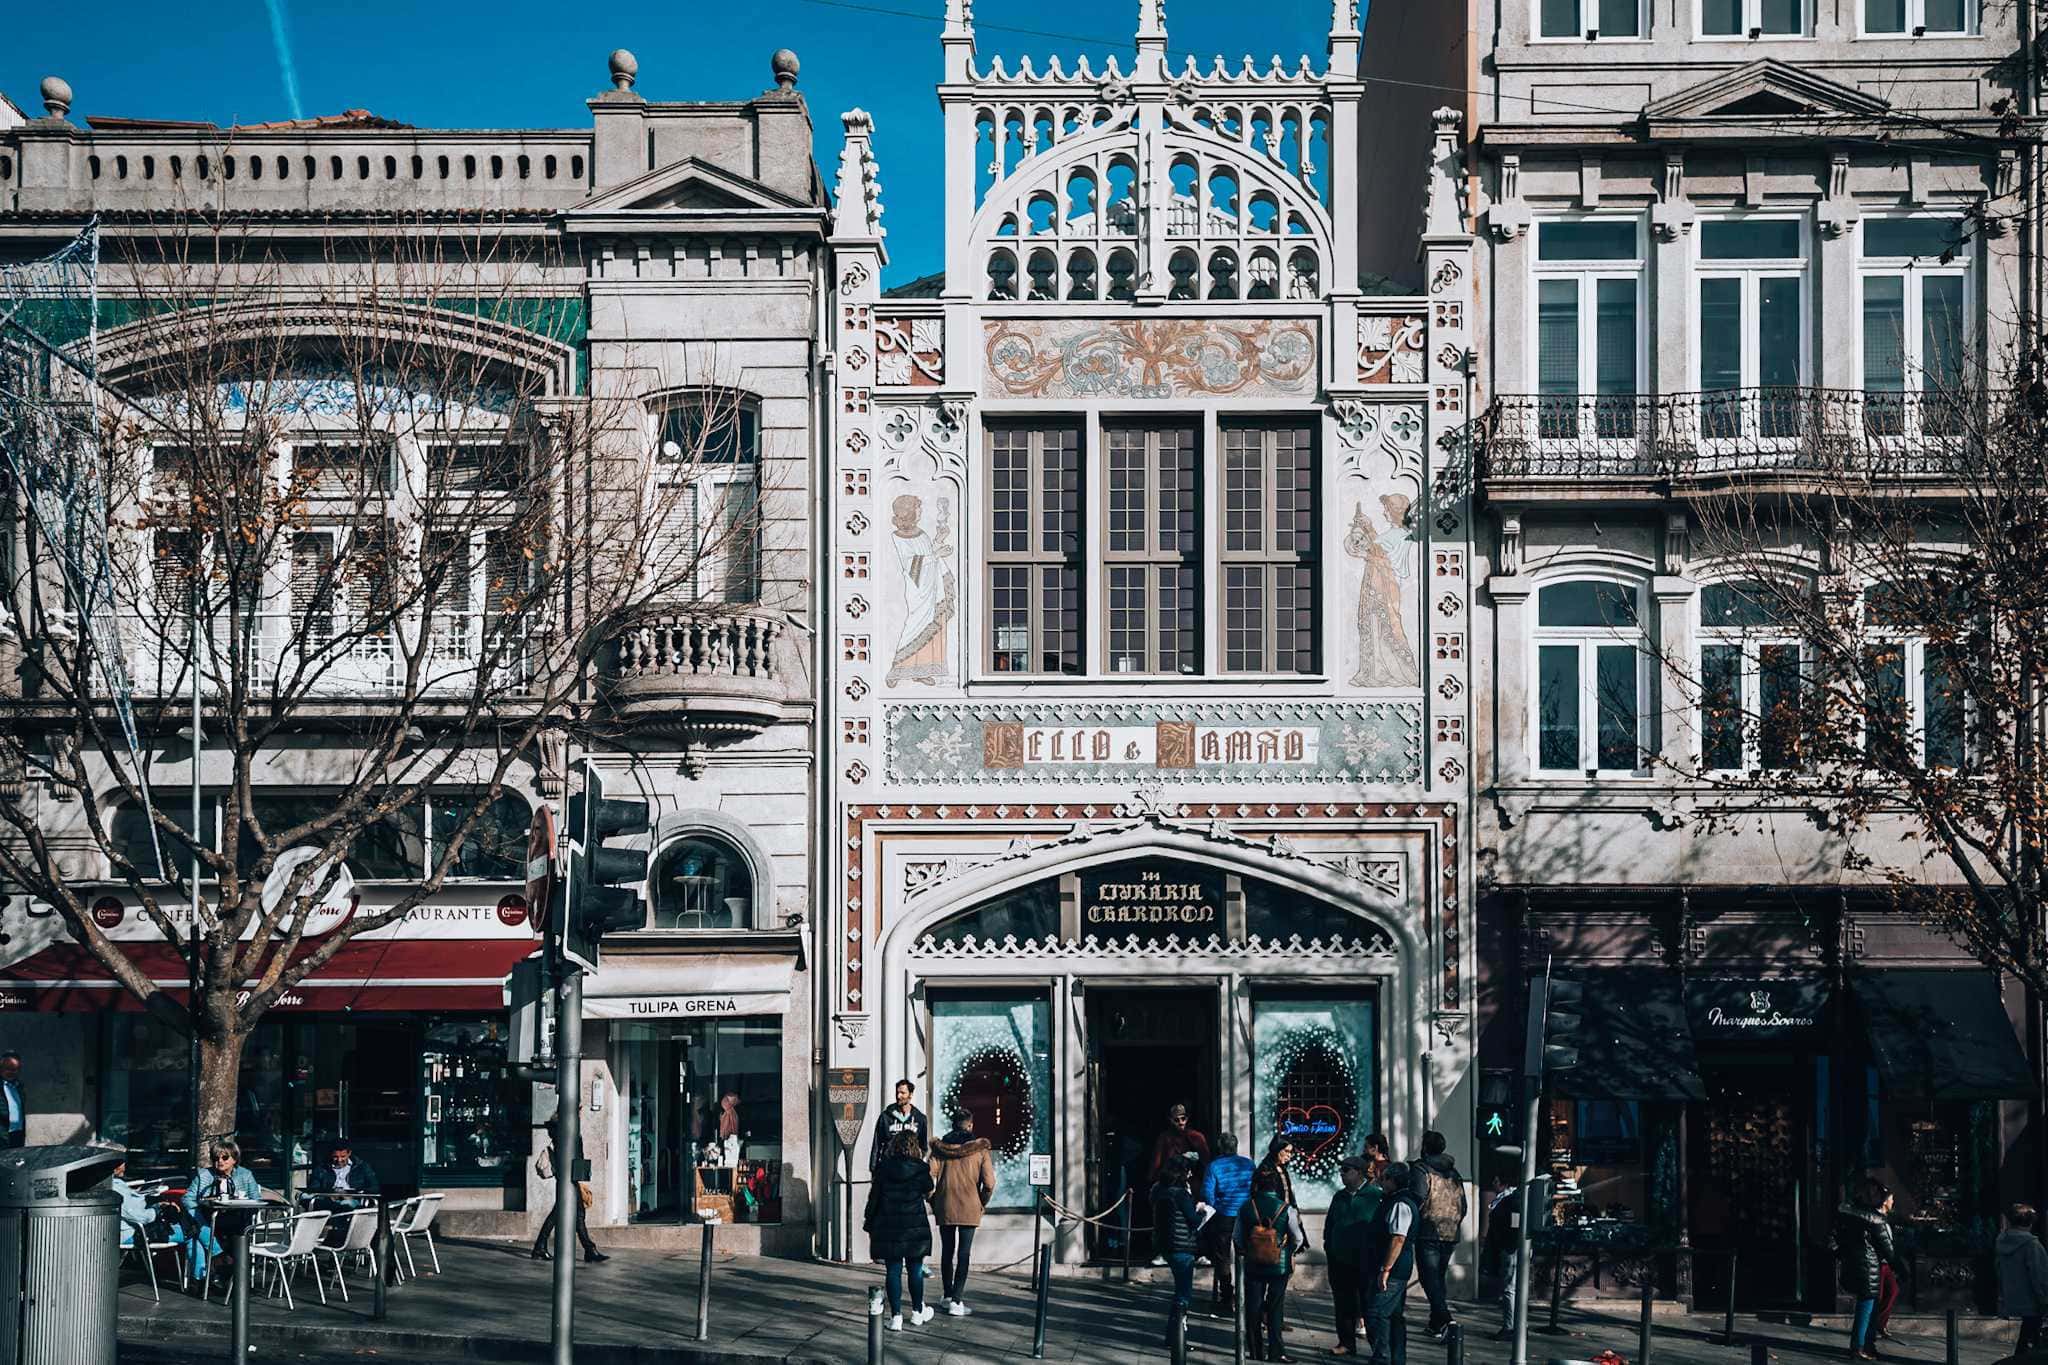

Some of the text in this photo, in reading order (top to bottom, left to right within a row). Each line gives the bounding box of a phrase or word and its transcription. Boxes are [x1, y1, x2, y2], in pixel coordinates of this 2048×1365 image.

[984, 721, 1110, 768] LELLO
[1098, 883, 1203, 901] LIVRARIA
[367, 907, 491, 921] RAURANTE
[1087, 904, 1214, 923] CHARDRON
[629, 996, 737, 1014] TULIPA GRENÁ
[1708, 1007, 1814, 1029] Marques Soares
